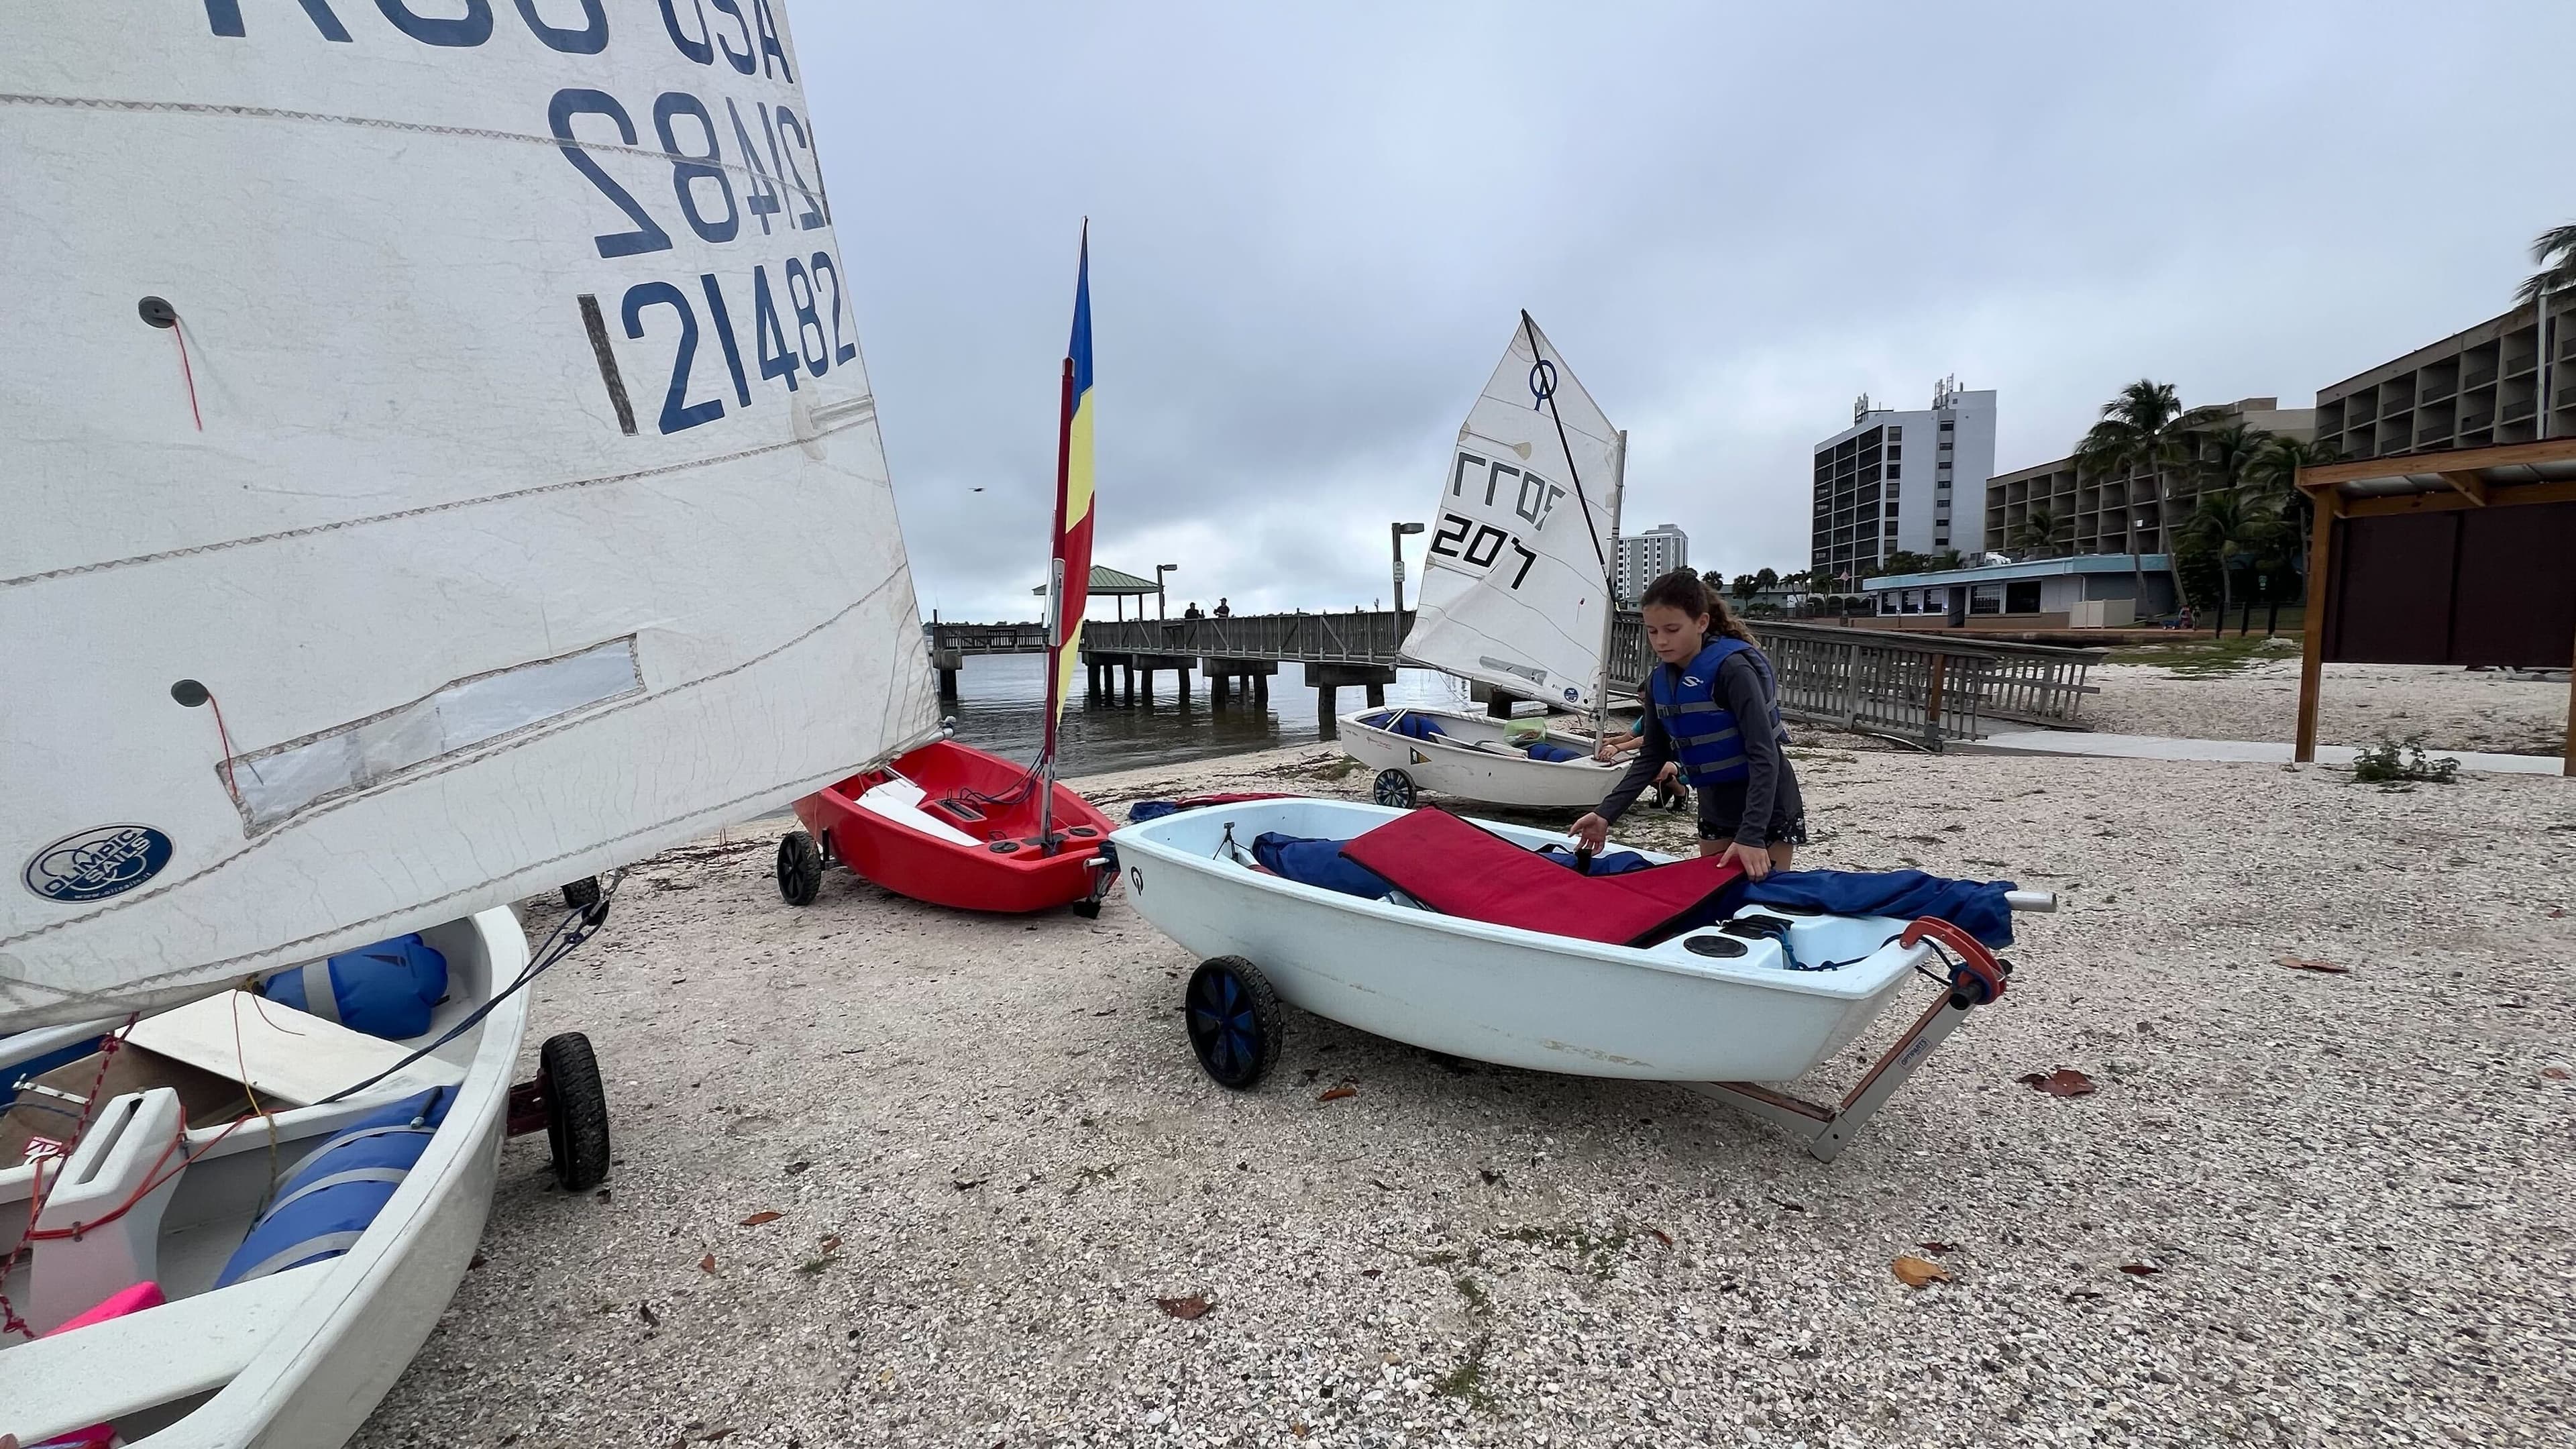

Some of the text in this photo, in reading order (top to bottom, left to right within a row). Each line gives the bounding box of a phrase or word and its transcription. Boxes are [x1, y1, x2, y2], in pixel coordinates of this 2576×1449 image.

[658, 0, 794, 84] USA
[44, 828, 138, 893] OLIMPIC
[85, 836, 151, 883] SAILS
